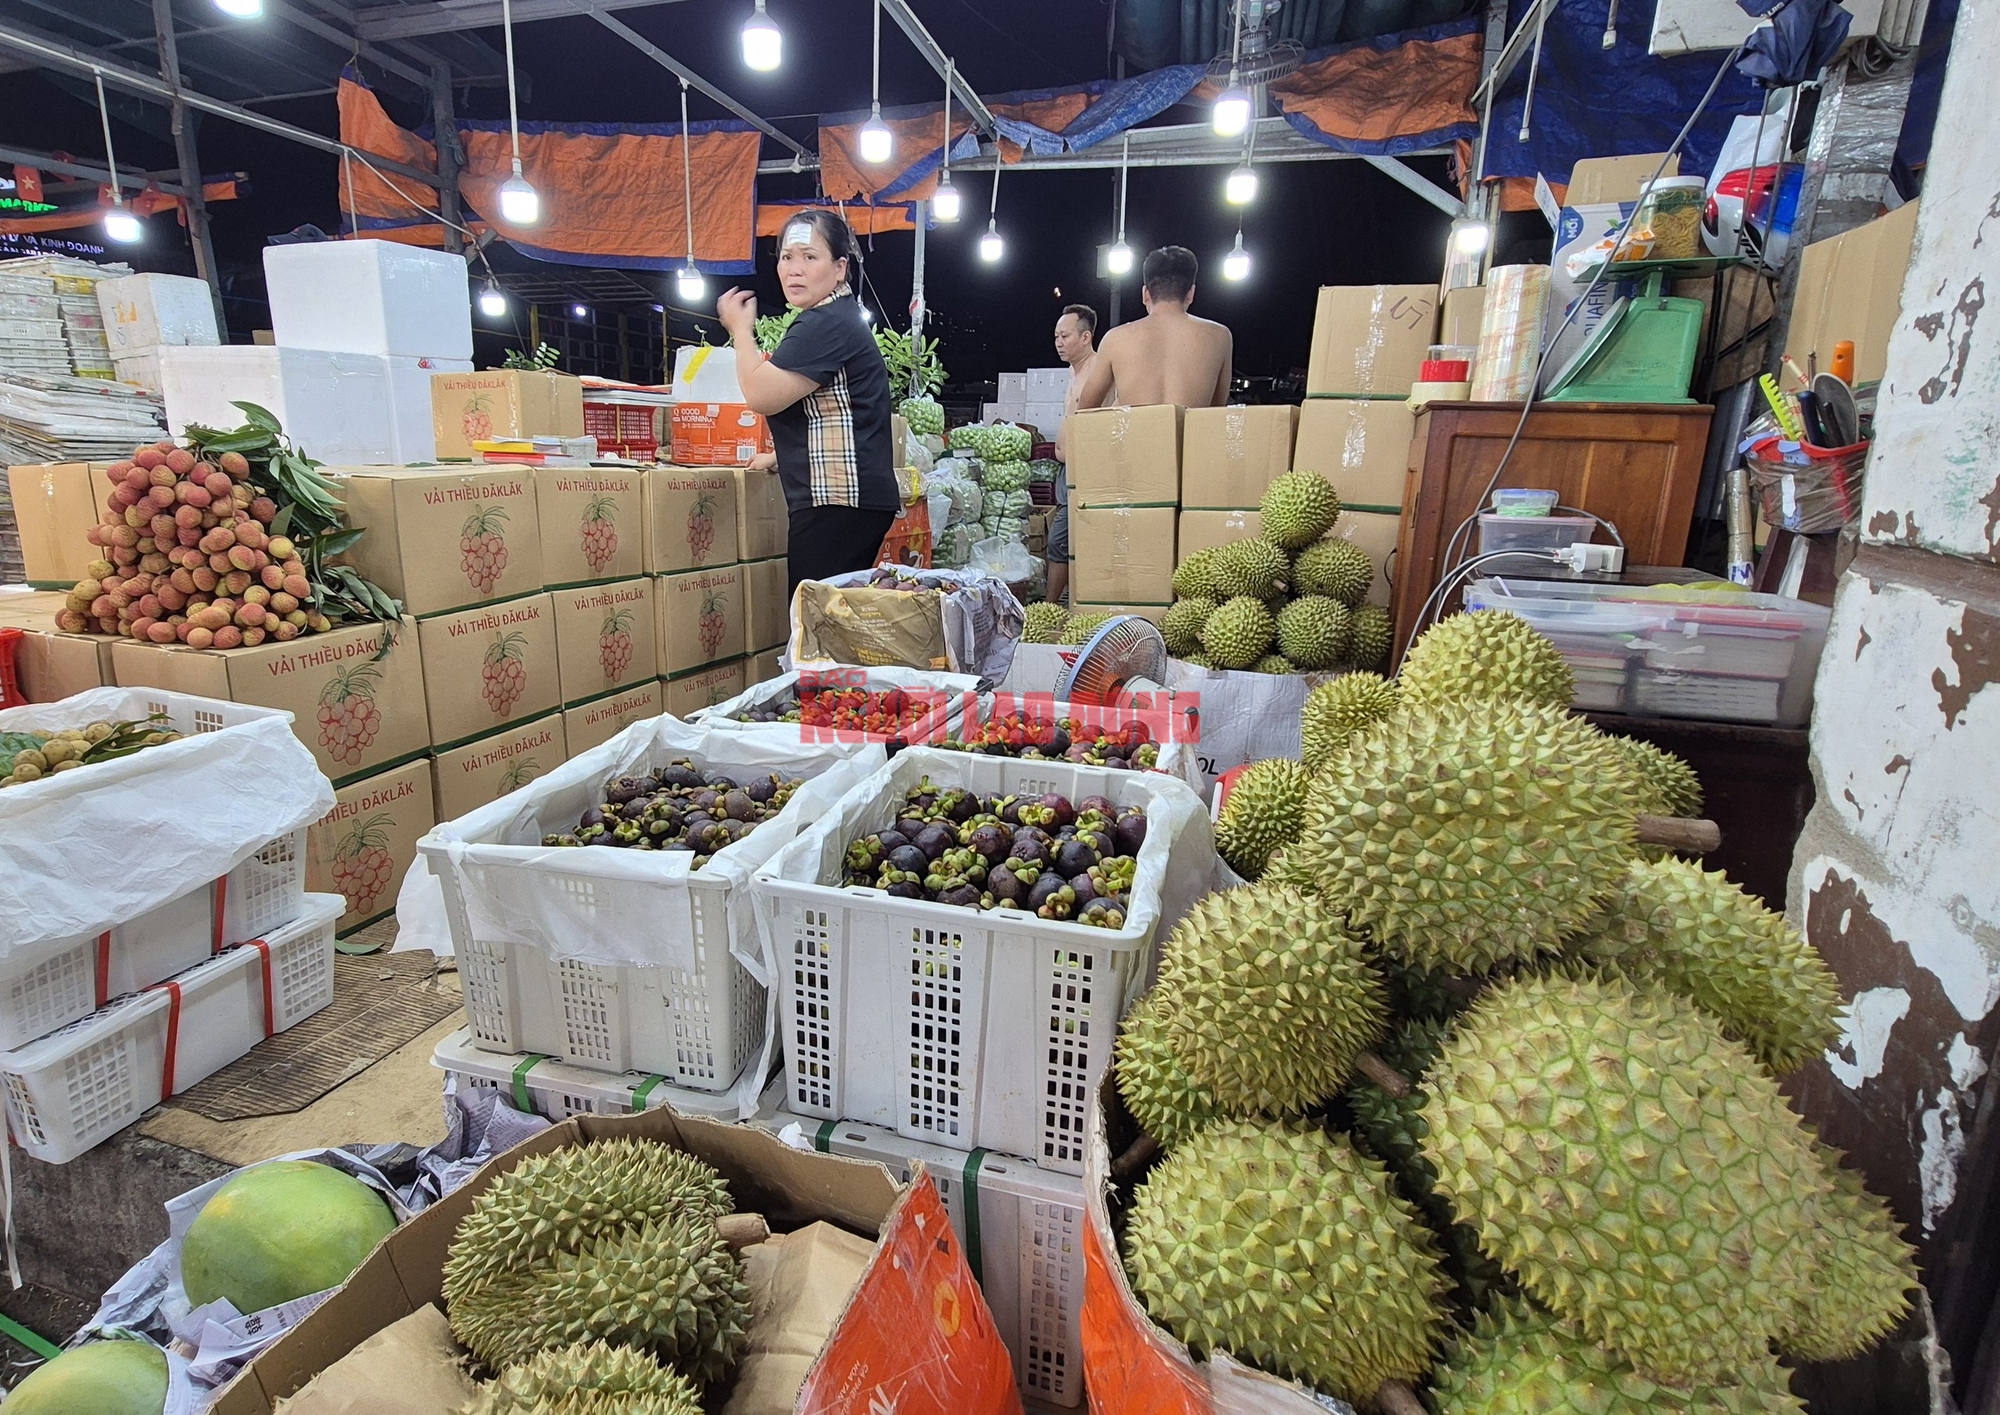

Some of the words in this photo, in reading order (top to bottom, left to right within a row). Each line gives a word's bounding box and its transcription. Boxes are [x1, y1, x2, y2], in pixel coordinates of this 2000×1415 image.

[40, 237, 65, 248] KINH
[67, 241, 104, 254] DOANH
[424, 487, 445, 504] VẢI
[447, 486, 479, 501] THIỀU
[556, 477, 571, 491] VẢI
[574, 595, 589, 610] VẢI
[590, 593, 613, 607] THIỀU
[448, 621, 467, 637] VẢI
[469, 613, 500, 633] THIỀU
[268, 655, 295, 676] VẢI
[298, 645, 342, 669] THIỀU
[346, 633, 399, 657] ĐĂKLK
[585, 709, 599, 725] VẢI
[600, 702, 623, 720] THIỀU
[462, 754, 482, 773] VẢI
[483, 745, 513, 766] THIỀU
[318, 801, 359, 827] HIỀU
[362, 781, 414, 810] ĐĂKLĂK
